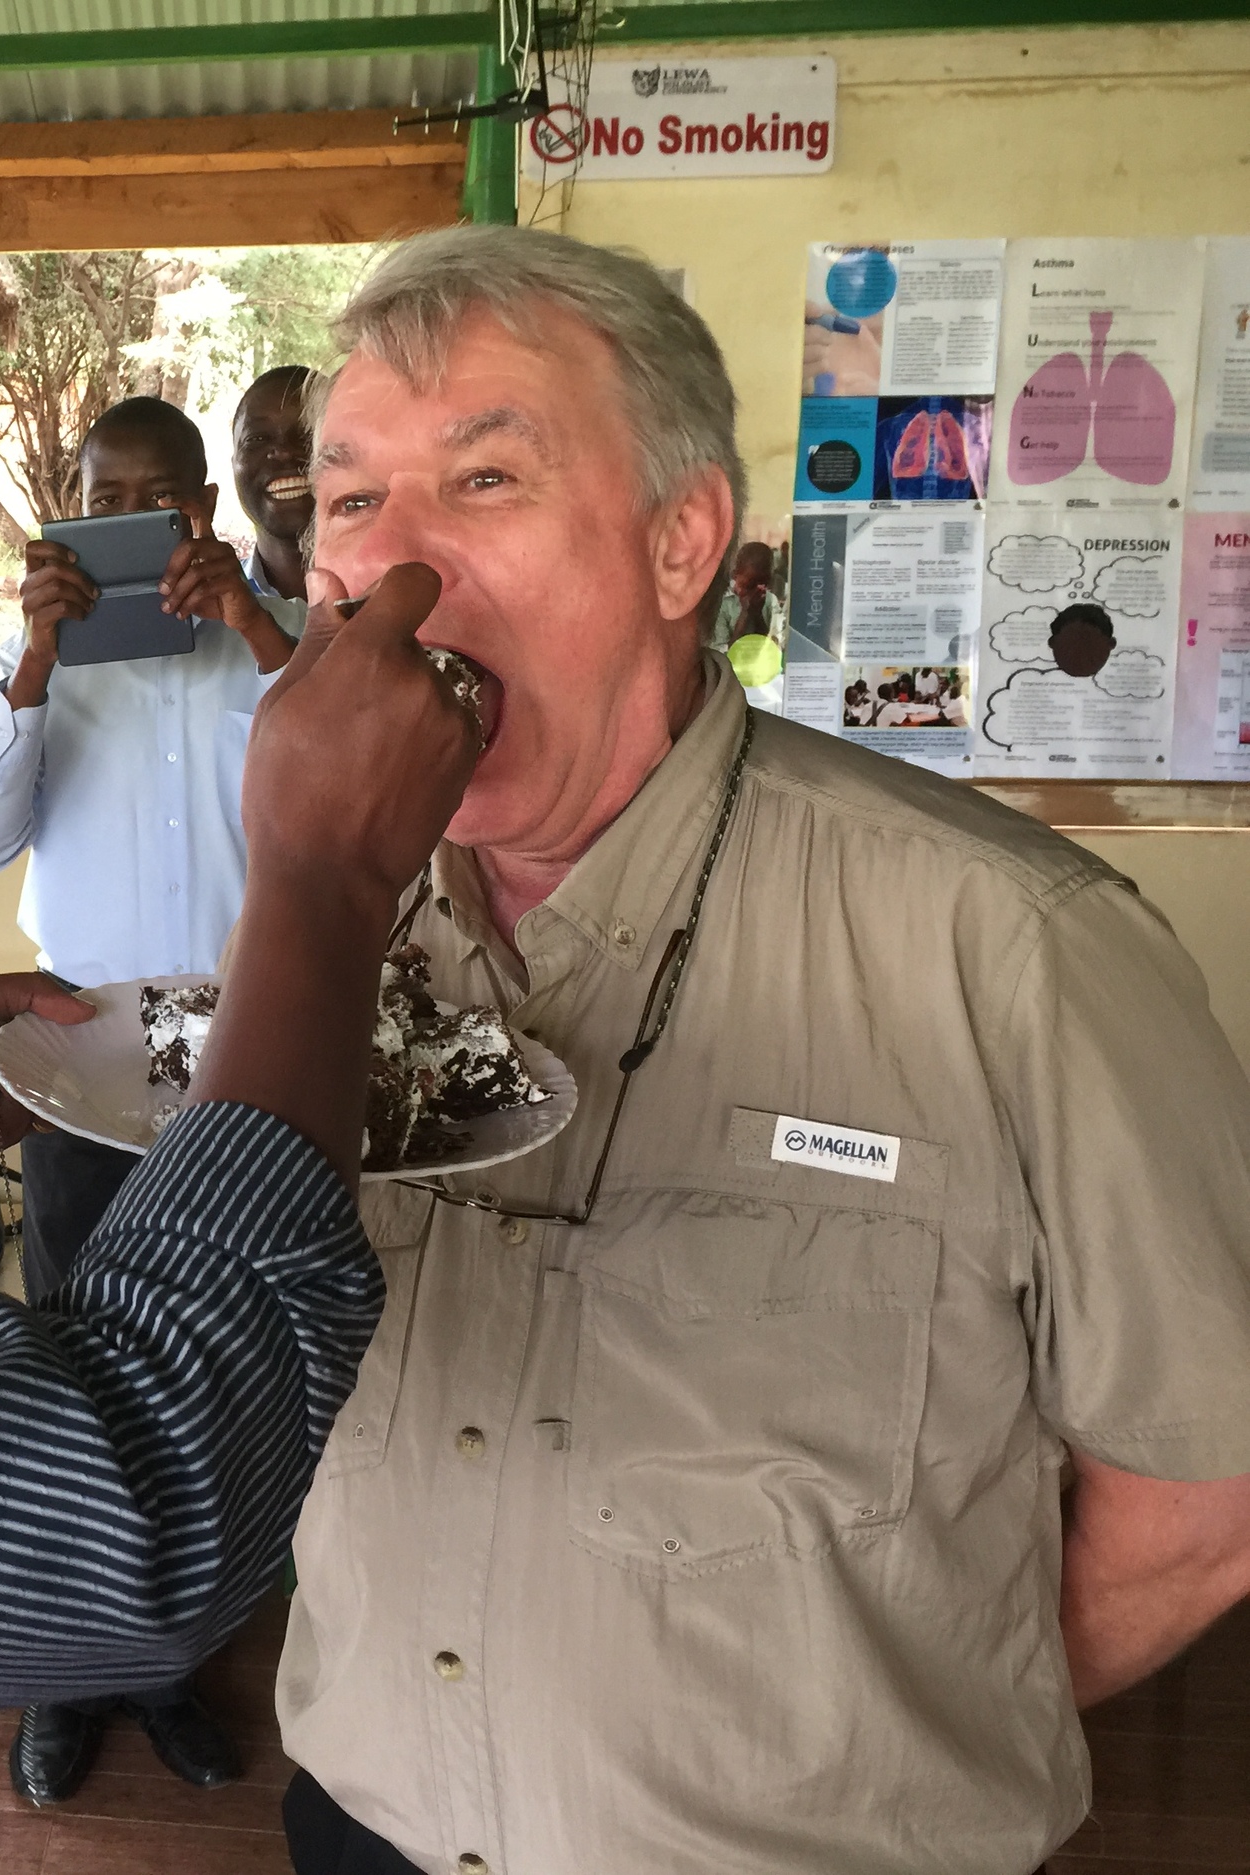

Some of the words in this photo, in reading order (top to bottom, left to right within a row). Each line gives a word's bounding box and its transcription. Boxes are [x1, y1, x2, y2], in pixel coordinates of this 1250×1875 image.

[662, 68, 711, 80] LEWA
[592, 117, 644, 157] No
[658, 112, 829, 161] Smoking
[1033, 258, 1075, 268] Asthma
[810, 521, 827, 571] Health
[1084, 538, 1171, 552] DEPRESSION
[806, 575, 825, 627] Mental
[809, 1134, 888, 1163] MAGELLAN
